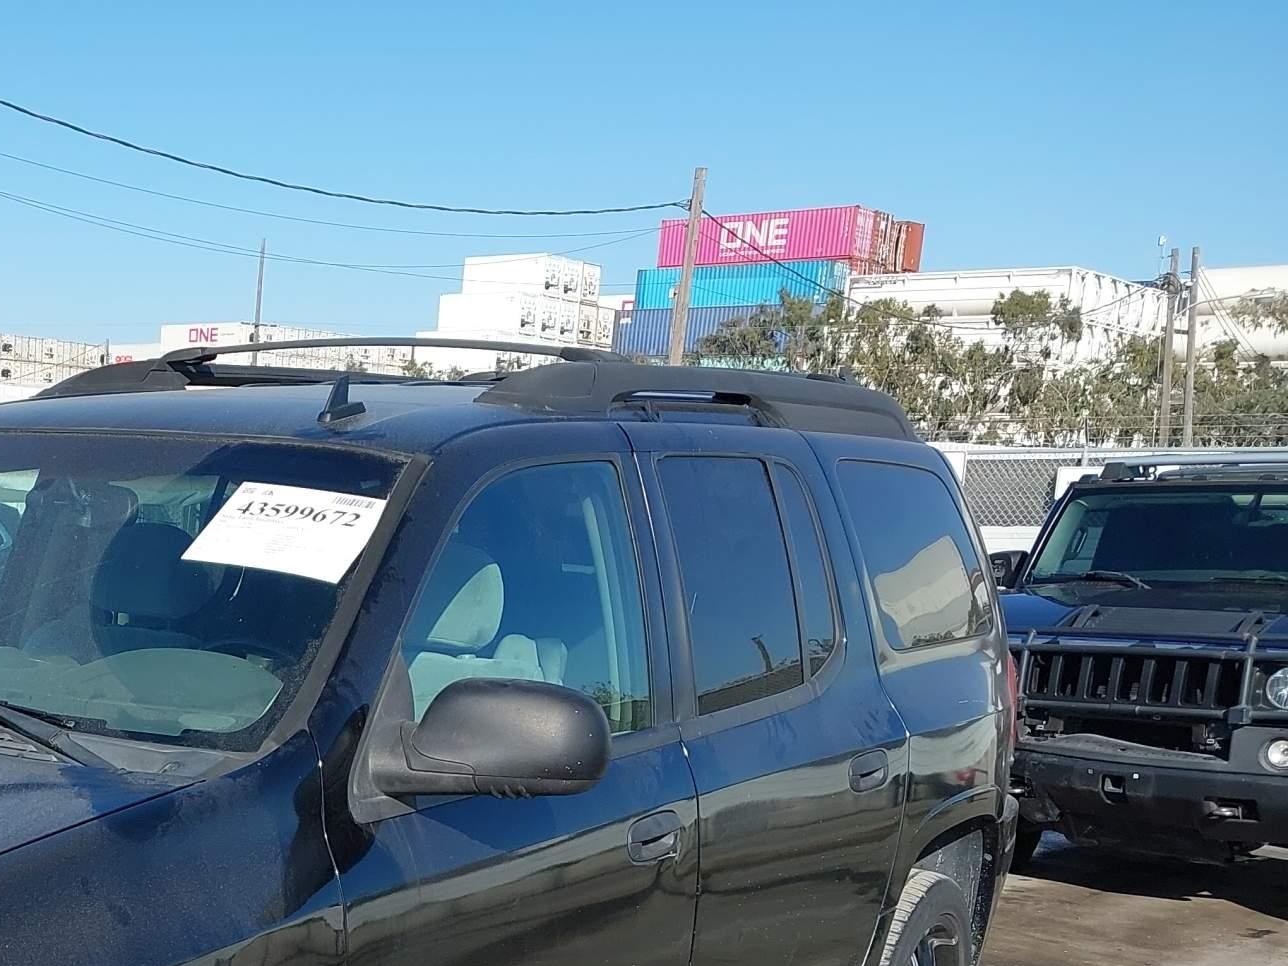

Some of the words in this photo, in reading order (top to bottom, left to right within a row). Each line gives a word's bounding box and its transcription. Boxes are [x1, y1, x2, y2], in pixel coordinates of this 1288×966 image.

[719, 218, 789, 248] ONE
[188, 327, 218, 343] ONE
[236, 500, 361, 527] 43599672
